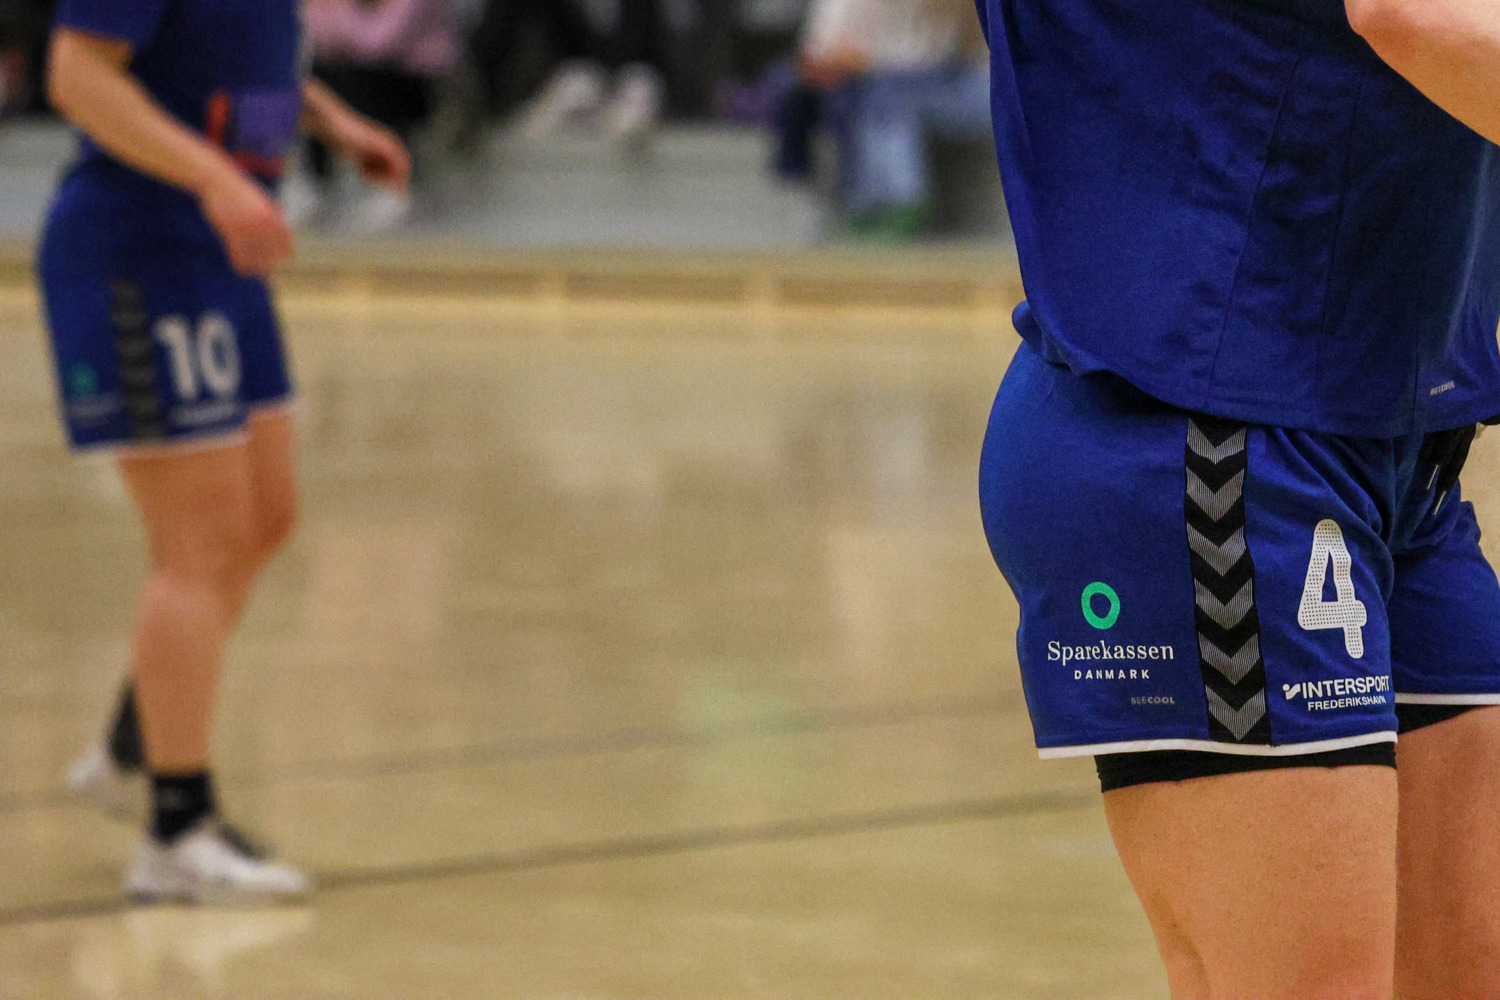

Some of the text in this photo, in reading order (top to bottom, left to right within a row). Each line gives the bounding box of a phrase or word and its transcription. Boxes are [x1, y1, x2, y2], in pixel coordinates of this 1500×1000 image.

[153, 312, 242, 400] 10
[1297, 518, 1368, 660] 4
[1047, 639, 1175, 667] Sparekassen
[1073, 669, 1151, 681] DANMARK
[1301, 674, 1390, 700] INTERSPORT
[1130, 696, 1176, 705] BEECOOL
[1307, 695, 1387, 712] FREDERIKSHAVN
